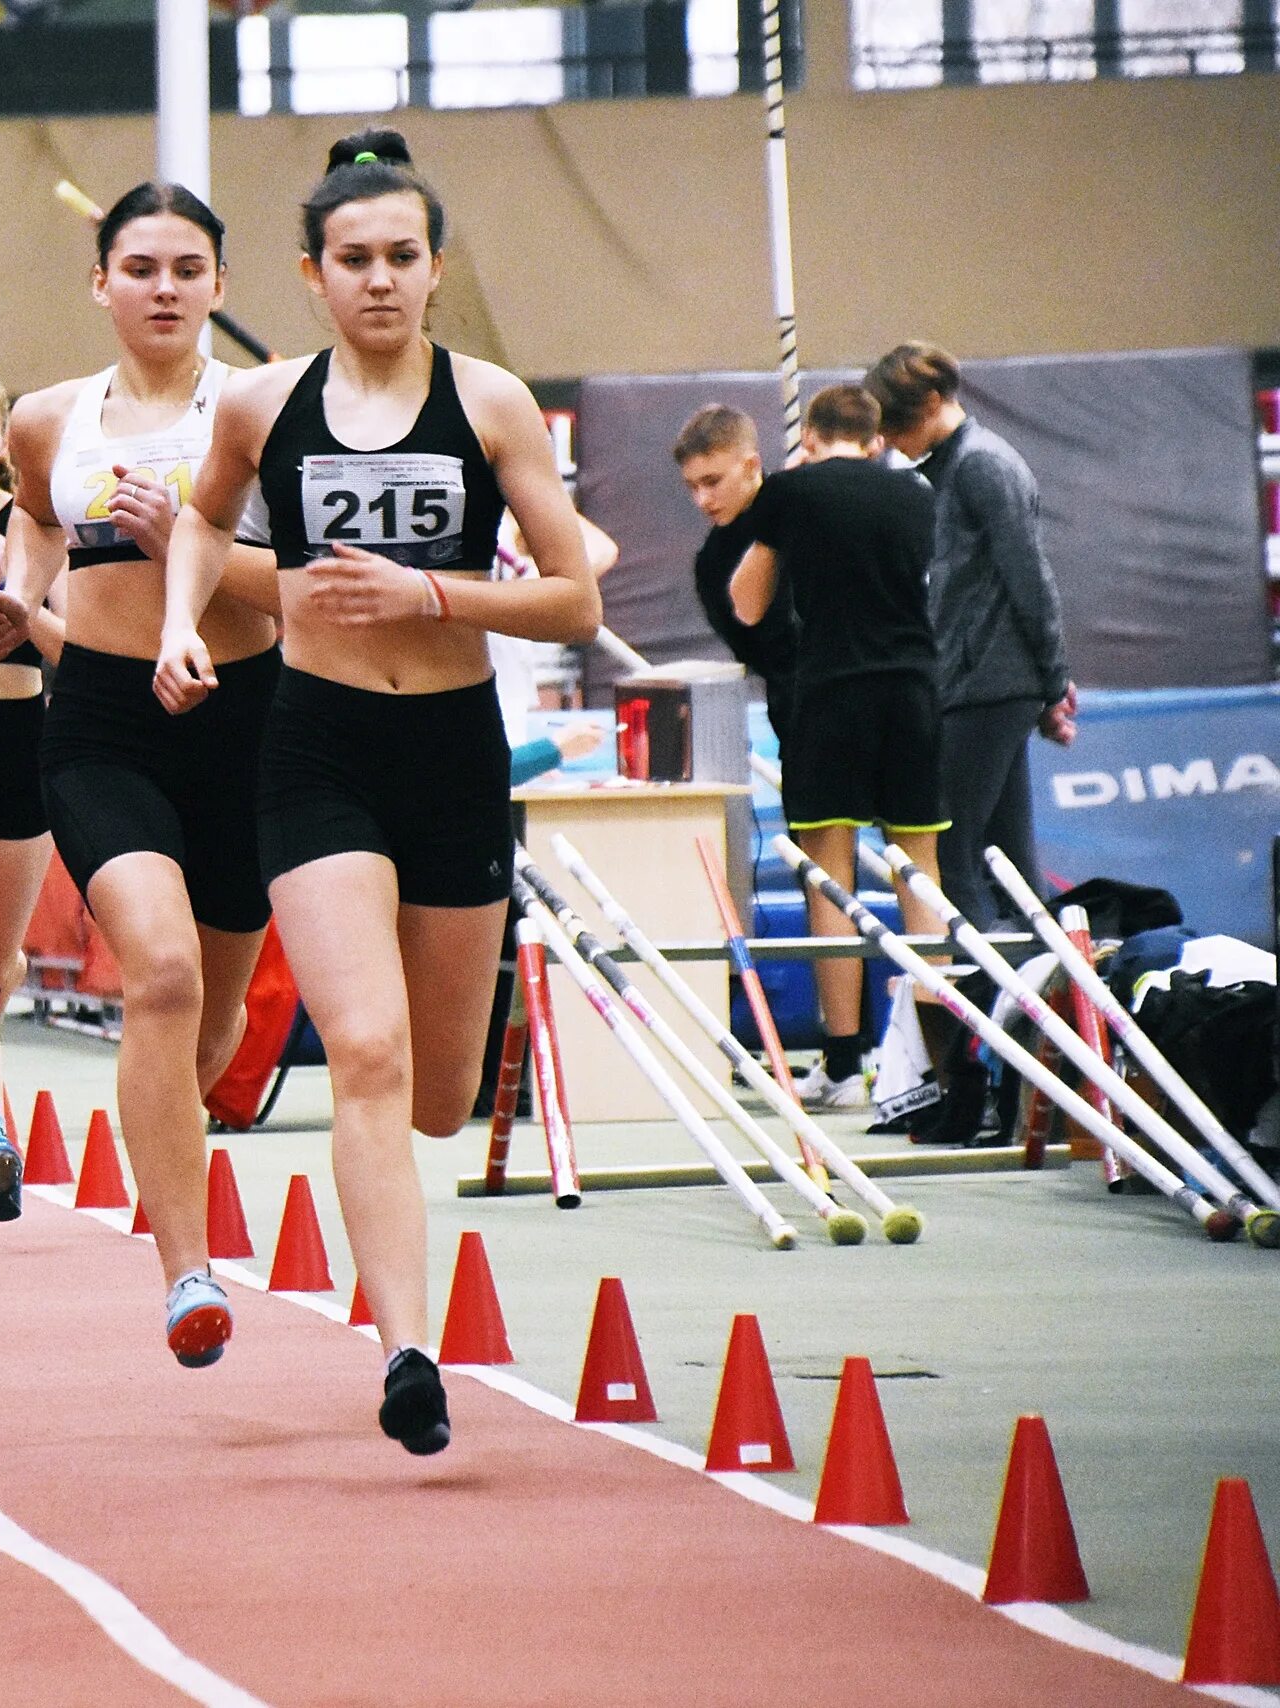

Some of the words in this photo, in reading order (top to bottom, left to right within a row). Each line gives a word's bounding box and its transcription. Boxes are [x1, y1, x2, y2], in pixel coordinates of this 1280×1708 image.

[83, 461, 195, 520] 21
[322, 488, 451, 540] 215
[1052, 754, 1280, 809] DIMA
